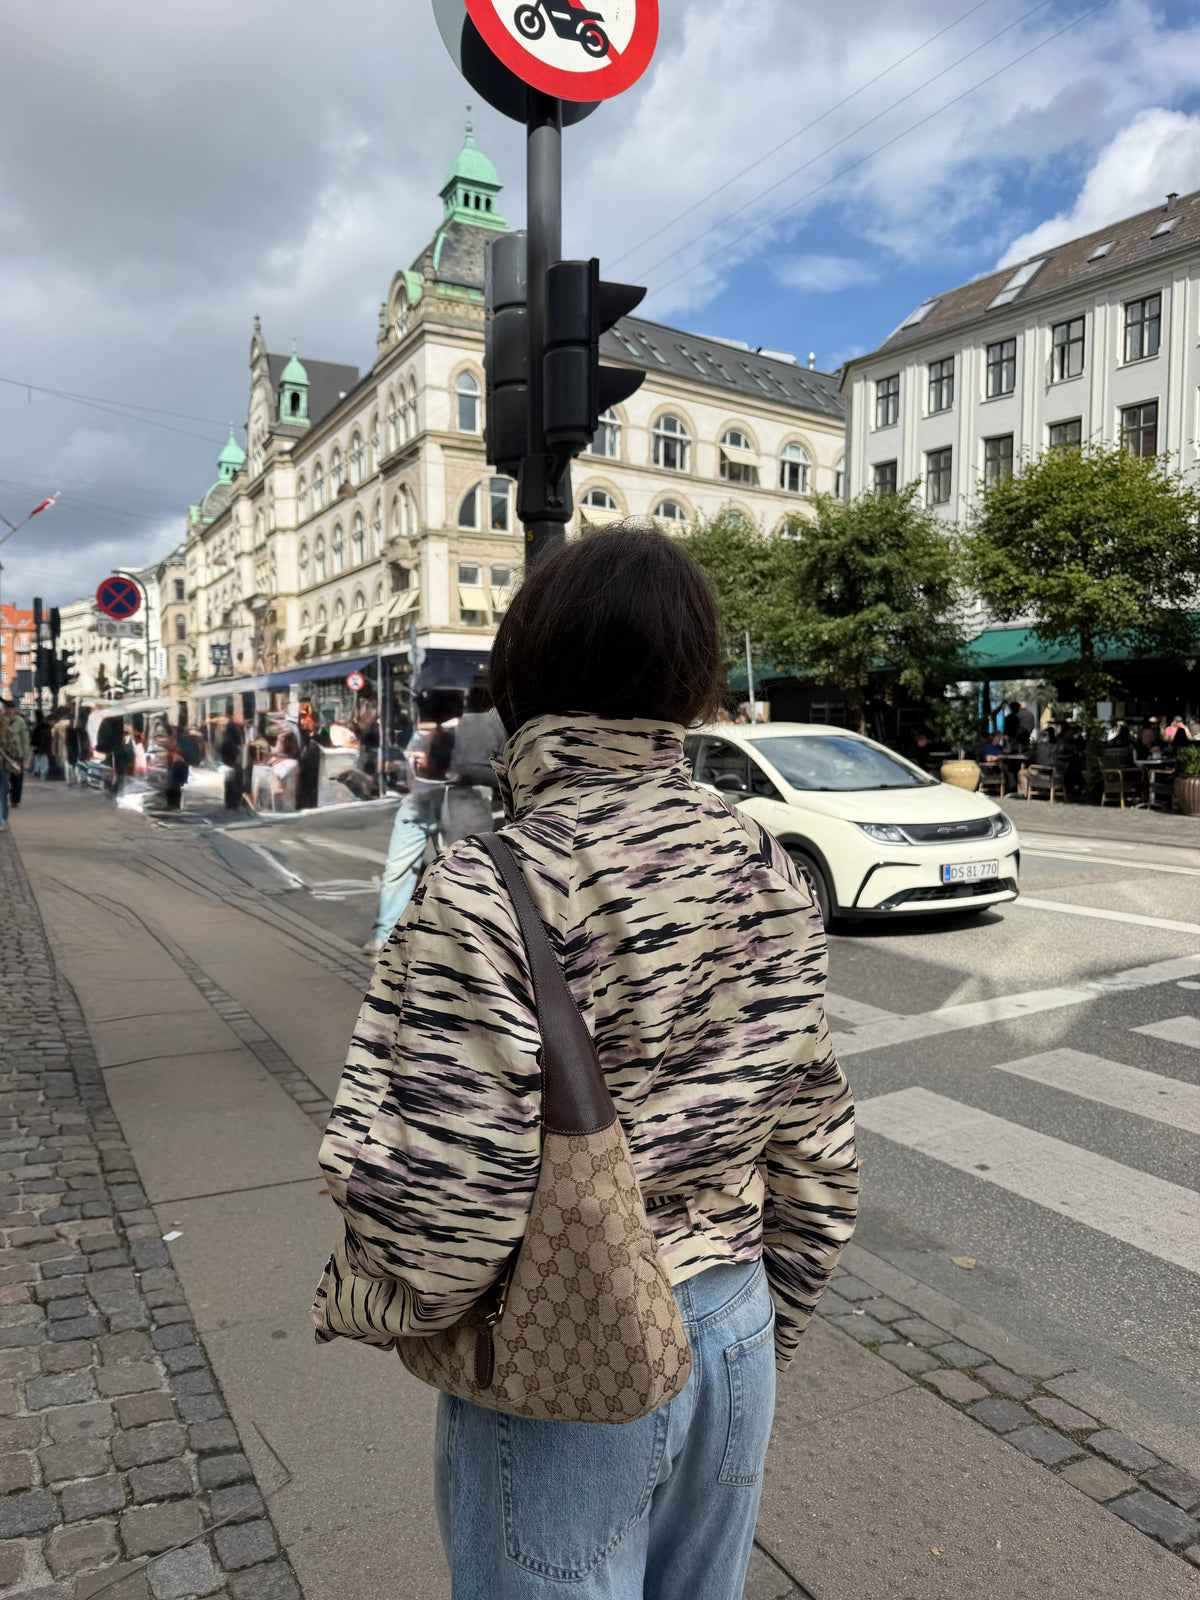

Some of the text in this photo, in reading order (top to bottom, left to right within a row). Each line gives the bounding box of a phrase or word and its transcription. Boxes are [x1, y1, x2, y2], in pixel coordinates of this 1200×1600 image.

[526, 530, 534, 541] 5
[951, 863, 997, 879] DS 81 770
